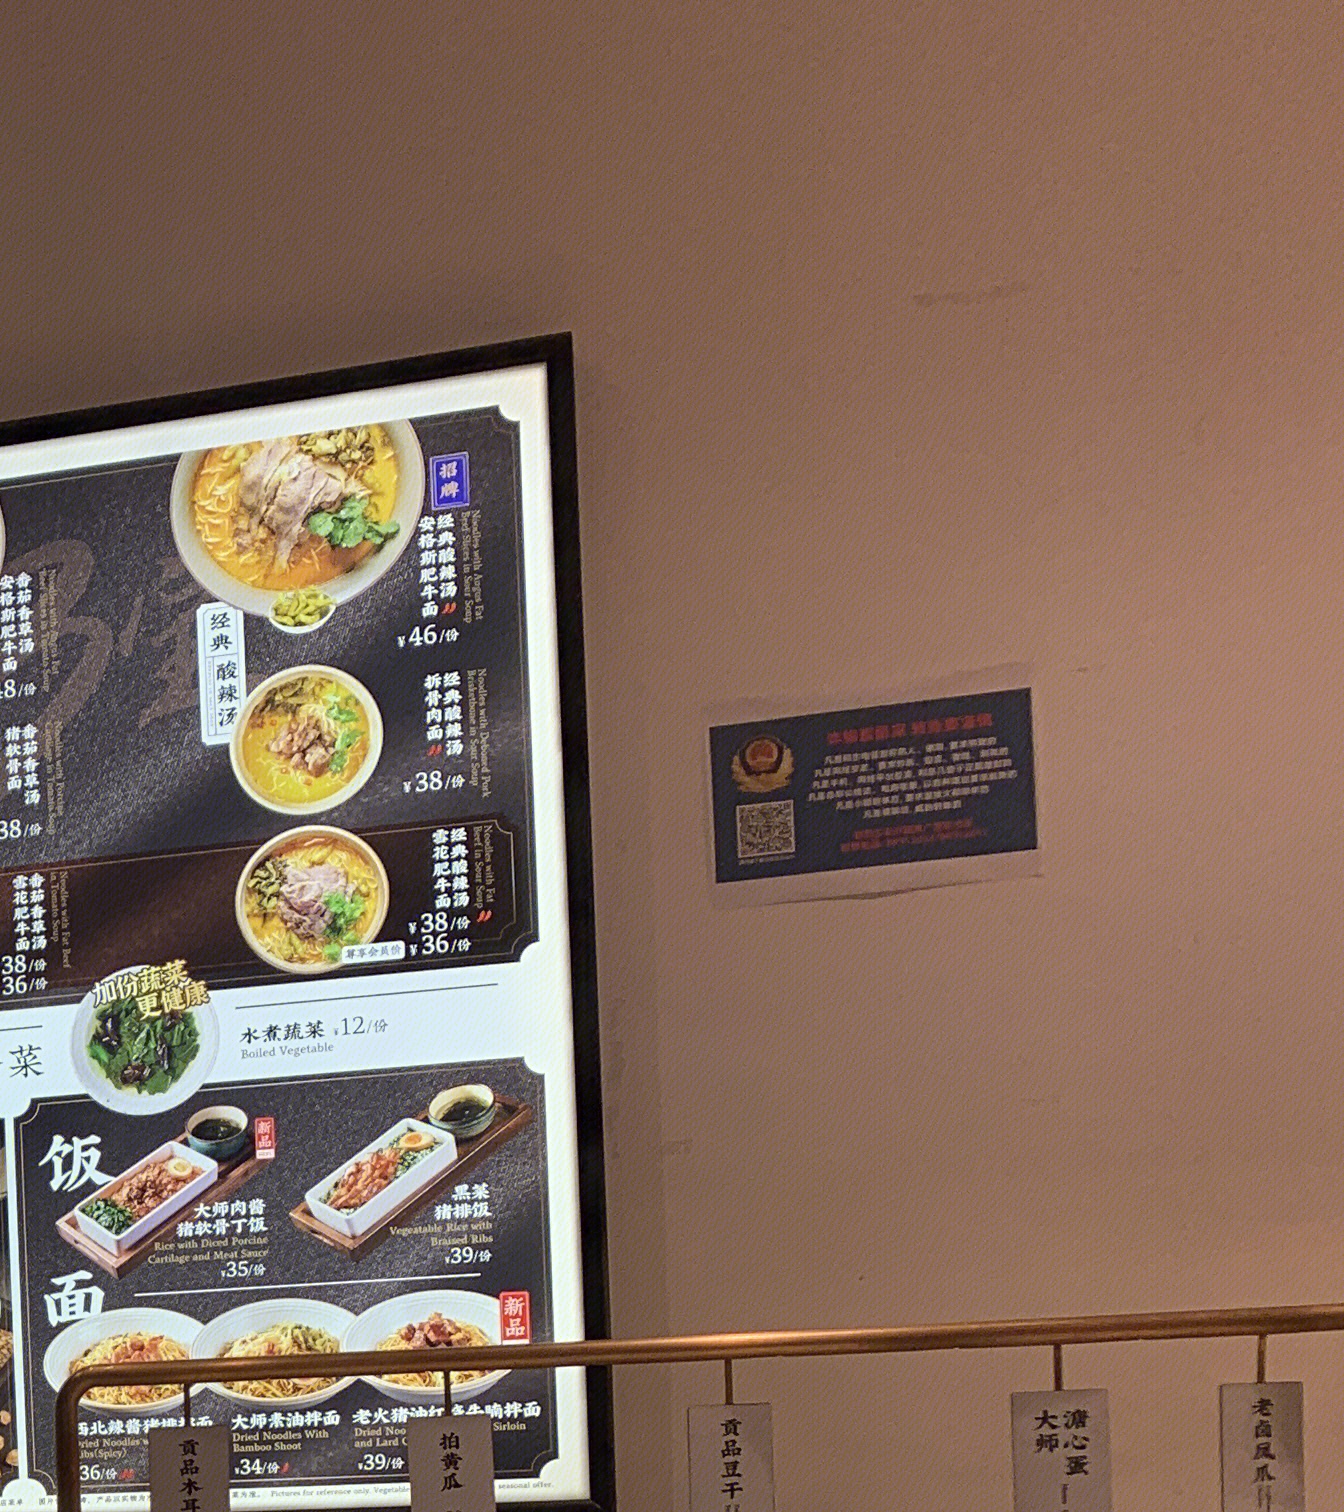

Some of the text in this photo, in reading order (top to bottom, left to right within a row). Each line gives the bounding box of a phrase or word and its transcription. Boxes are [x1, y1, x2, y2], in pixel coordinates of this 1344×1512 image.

[438, 461, 460, 499] 招牌
[418, 517, 439, 618] 安格斯肥牛面
[437, 513, 458, 600] 经典酸辣汤
[15, 571, 35, 655] 番茄香草汤
[209, 612, 234, 652] 经典
[396, 624, 460, 648] ¥46/份
[215, 661, 239, 727] 酸辣汤
[424, 674, 444, 743] 拆骨肉面
[443, 671, 464, 757] 经典酸辣汤
[4, 726, 23, 792] 猪软骨面
[22, 723, 42, 806] 番茄香草汤
[403, 771, 466, 794] ¥38/份
[450, 827, 470, 909] 经典酸辣汤
[29, 872, 48, 952] 番茄香草汤
[408, 912, 472, 936] ¥38/份
[345, 944, 402, 960] 尊享会员价
[409, 934, 472, 957] ¥36/份
[91, 959, 190, 1008] 加份蔬菜
[134, 979, 211, 1020] 更健康
[239, 1015, 389, 1045] 水煮蔬菜 ¥12/份
[240, 1043, 334, 1060] Boiled Vegetable
[38, 1133, 118, 1193] 饭
[176, 1216, 269, 1239] 猪软骨丁饭
[194, 1199, 267, 1218] 大师肉酱
[434, 1201, 493, 1221] 猪排饭
[220, 1261, 267, 1279] ¥35/份
[444, 1247, 493, 1265] ¥39/份
[43, 1269, 105, 1327] 面
[503, 1296, 526, 1338] 新品
[231, 1410, 341, 1431] 大师素油拌面
[1034, 1409, 1060, 1453] 大师
[1251, 1397, 1276, 1484] 老卤凤爪
[358, 1453, 406, 1471] ¥39/份
[439, 1431, 463, 1493] 拍黄瓜
[1062, 1408, 1090, 1476] 溏心蛋
[234, 1455, 280, 1476] ¥34/份
